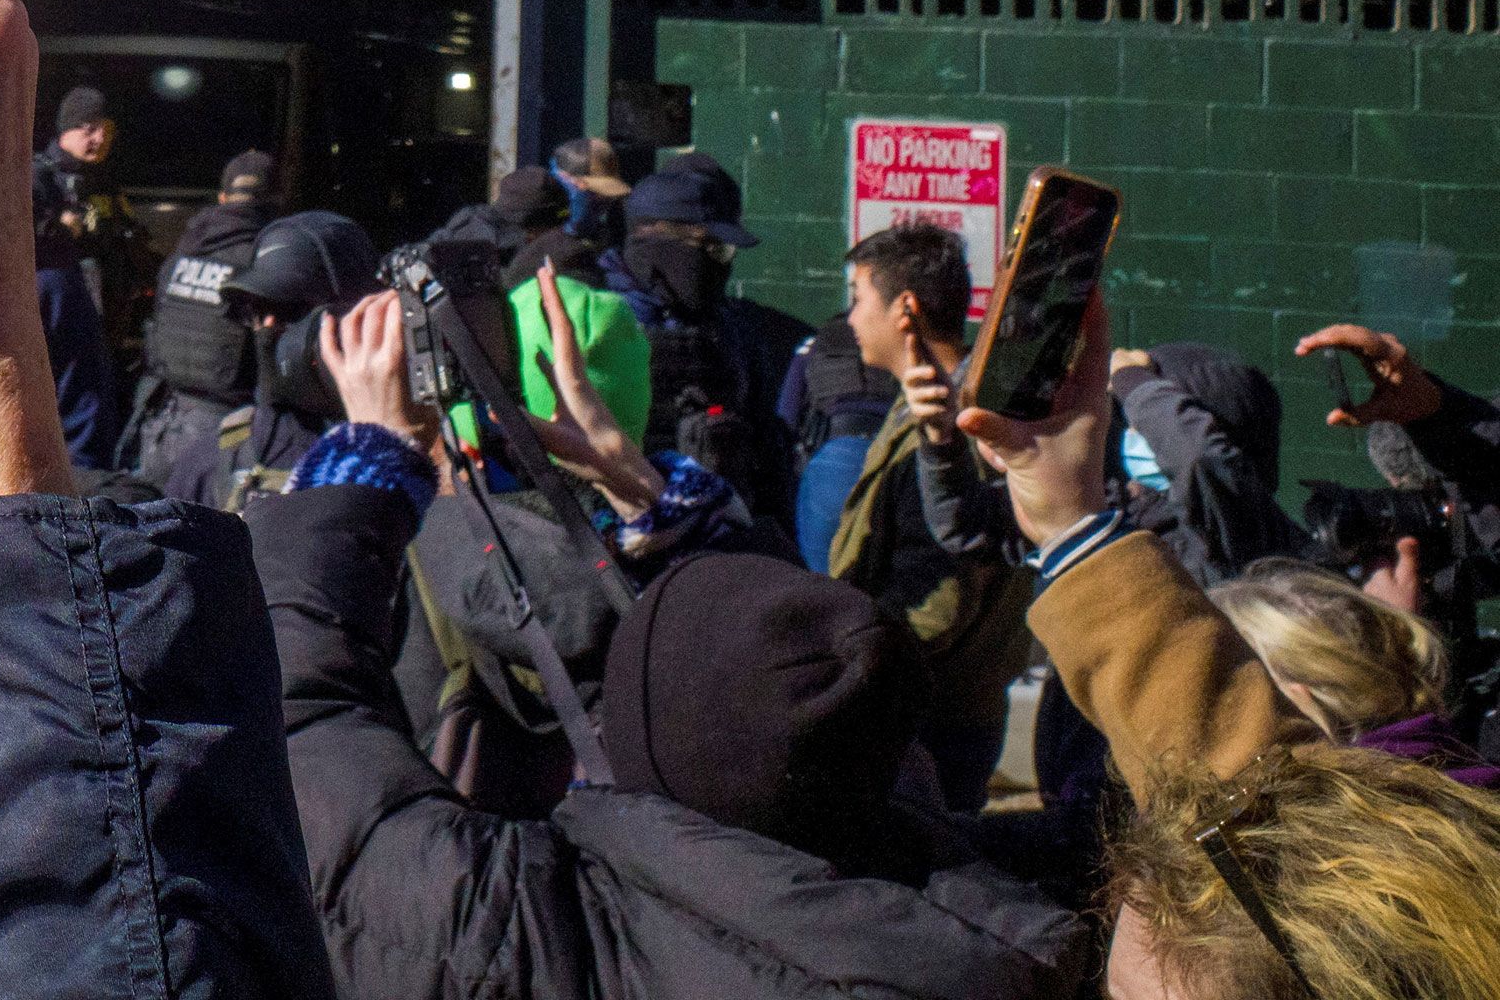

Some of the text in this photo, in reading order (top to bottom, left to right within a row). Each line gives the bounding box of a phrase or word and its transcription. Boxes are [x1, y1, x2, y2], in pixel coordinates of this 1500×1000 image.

[863, 136, 993, 170] NO PARKING
[883, 171, 971, 201] ANY TIME
